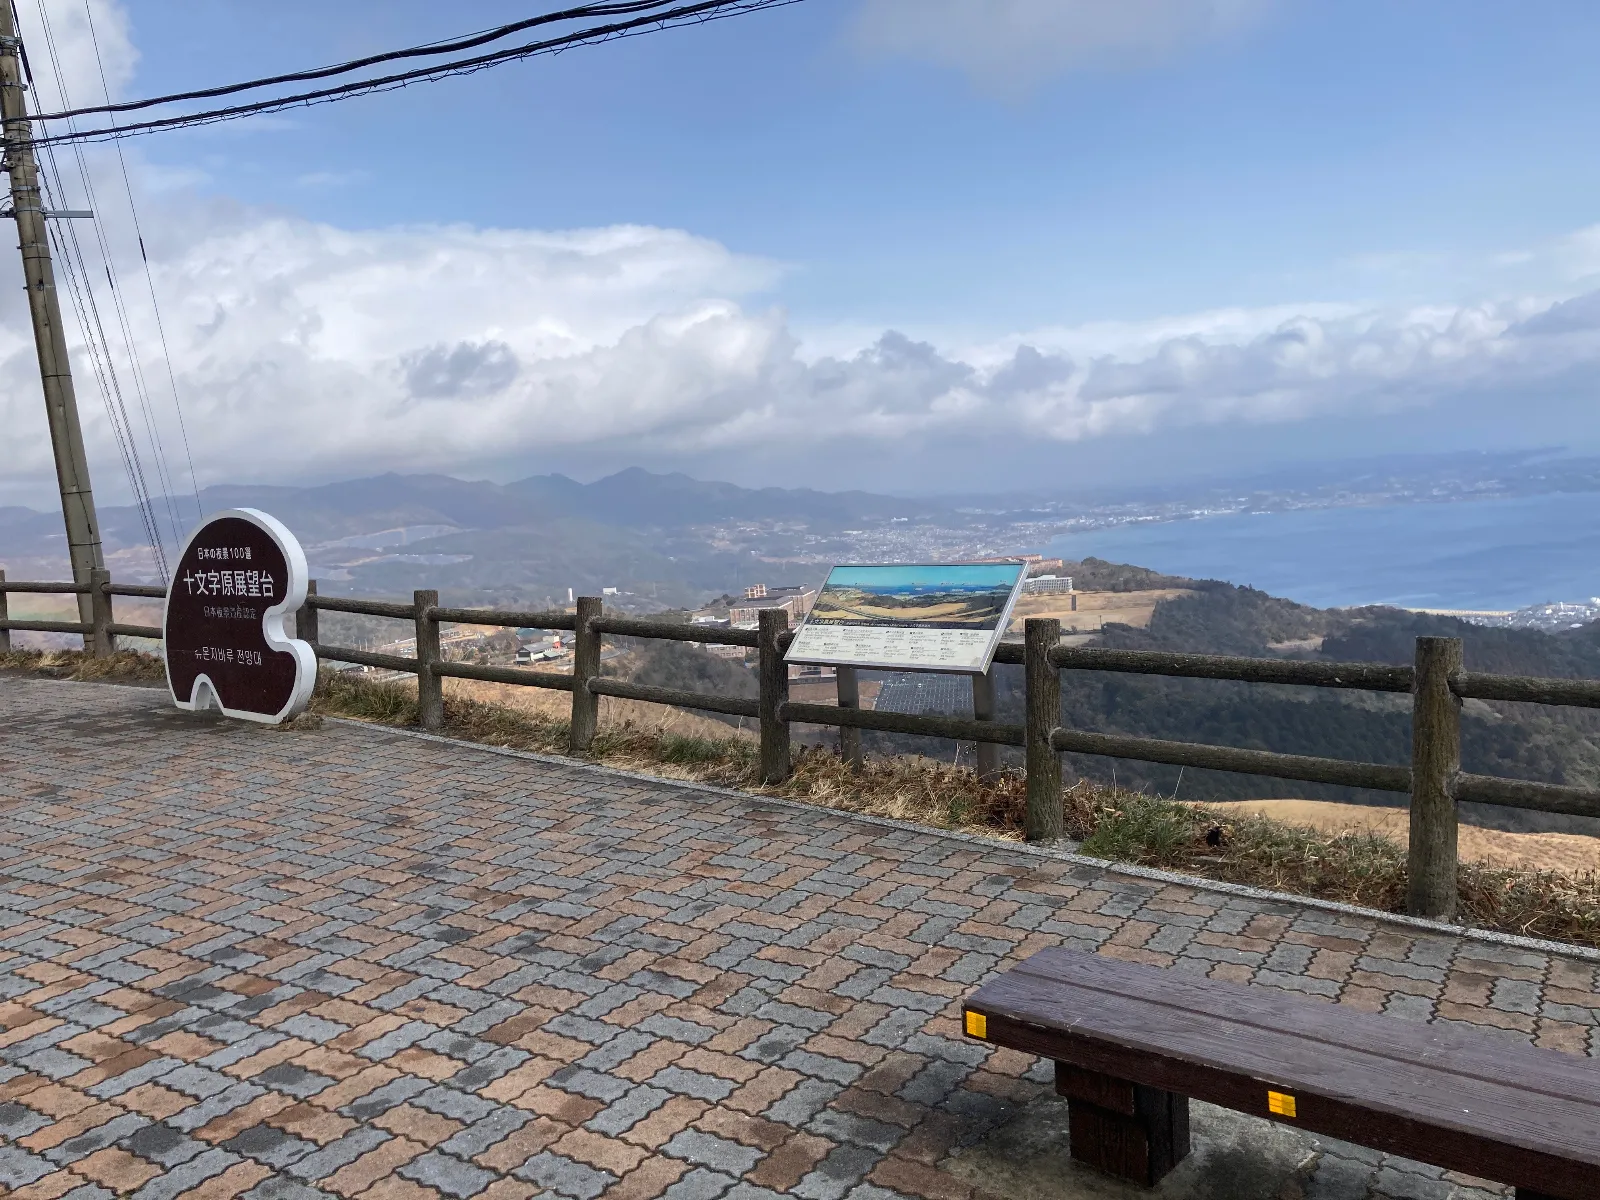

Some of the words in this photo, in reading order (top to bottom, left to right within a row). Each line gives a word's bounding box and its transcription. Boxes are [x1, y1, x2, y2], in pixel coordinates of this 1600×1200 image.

[182, 569, 275, 598] 十文字原展望台
[236, 649, 262, 666] 전망대
